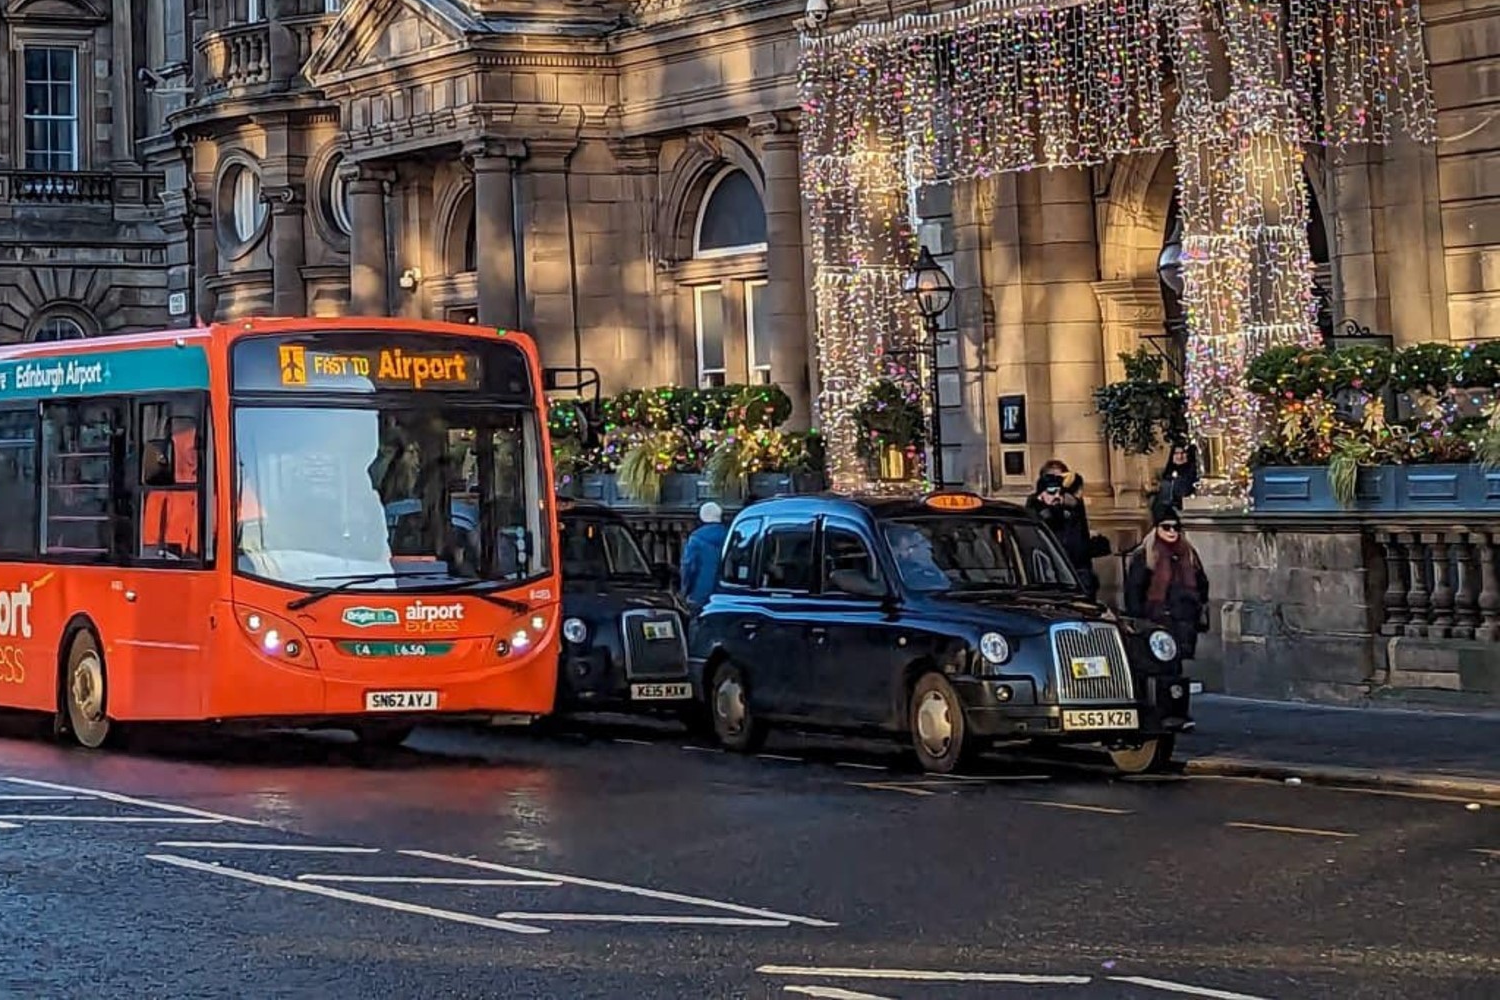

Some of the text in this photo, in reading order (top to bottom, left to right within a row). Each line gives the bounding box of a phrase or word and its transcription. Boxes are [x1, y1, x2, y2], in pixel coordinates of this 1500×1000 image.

[16, 362, 64, 392] Edinburgh
[66, 360, 102, 391] Airport
[314, 348, 467, 389] FAST TO Airport
[405, 600, 464, 622] airport
[372, 694, 432, 707] SN62 AYJ
[1069, 711, 1133, 726] LS63 KZR
